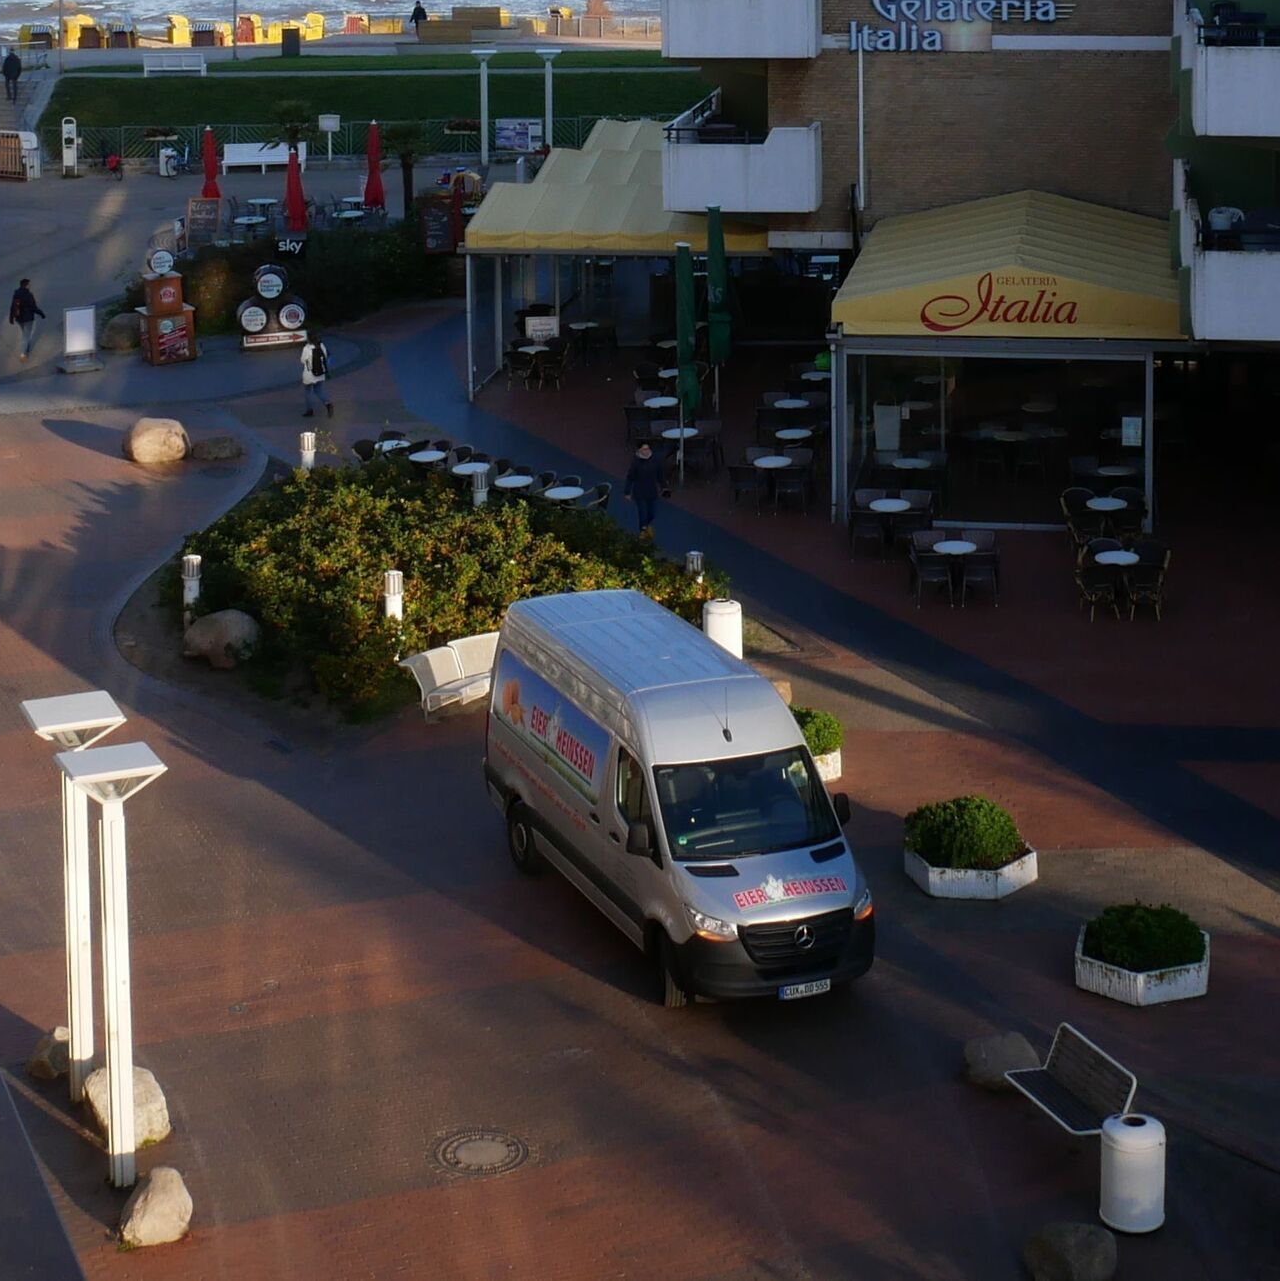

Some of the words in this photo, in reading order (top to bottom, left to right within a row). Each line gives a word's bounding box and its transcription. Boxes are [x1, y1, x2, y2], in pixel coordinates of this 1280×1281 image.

[849, 21, 943, 52] Italia
[278, 239, 303, 254] sky
[996, 276, 1058, 287] GELATERIA
[920, 272, 1078, 332] Italia
[531, 706, 549, 736] EIER
[556, 727, 595, 779] HEINSSEN
[734, 887, 768, 908] EIER
[783, 877, 847, 897] HEINSSEN
